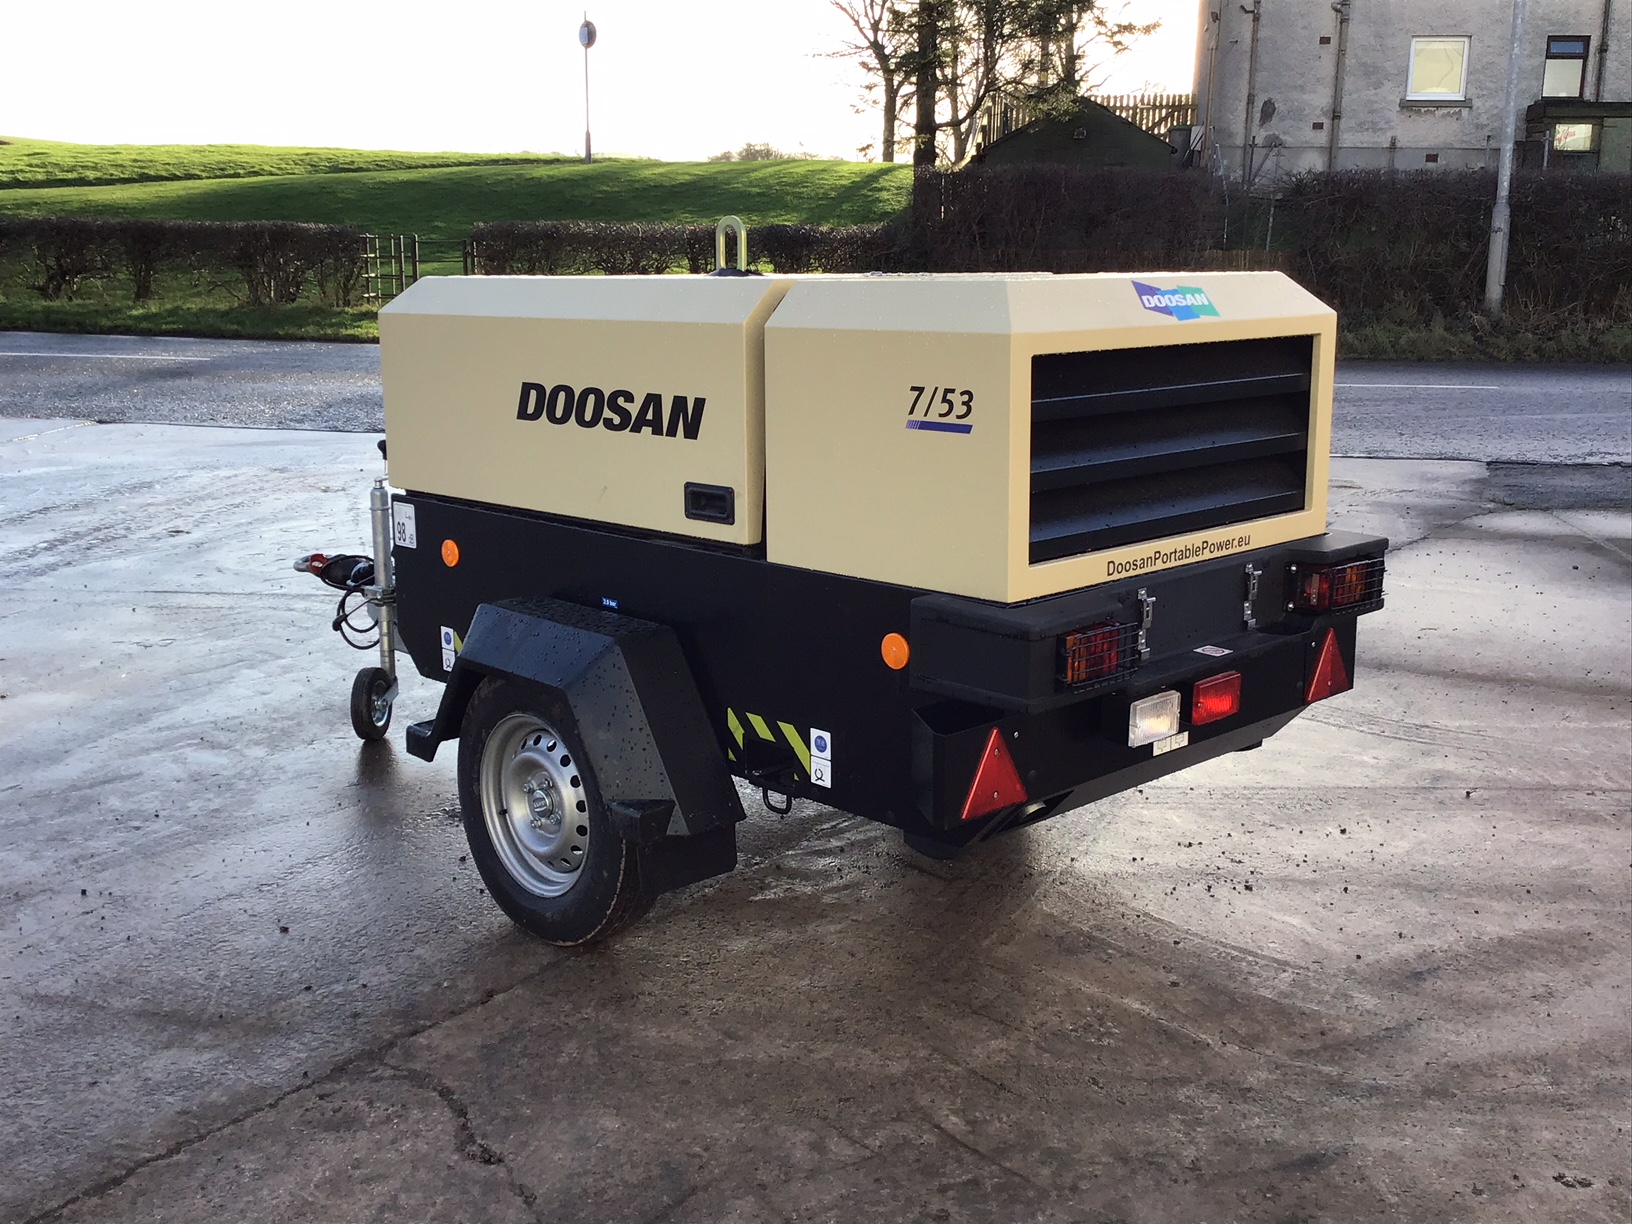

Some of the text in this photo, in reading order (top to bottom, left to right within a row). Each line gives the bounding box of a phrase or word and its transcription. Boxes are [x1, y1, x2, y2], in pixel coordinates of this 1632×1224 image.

[1141, 293, 1209, 308] DOOSAN
[516, 381, 706, 440] DOOSAN
[908, 386, 974, 420] 7/53
[397, 521, 406, 543] 98
[1106, 534, 1251, 577] DoosanPortablePower.eu
